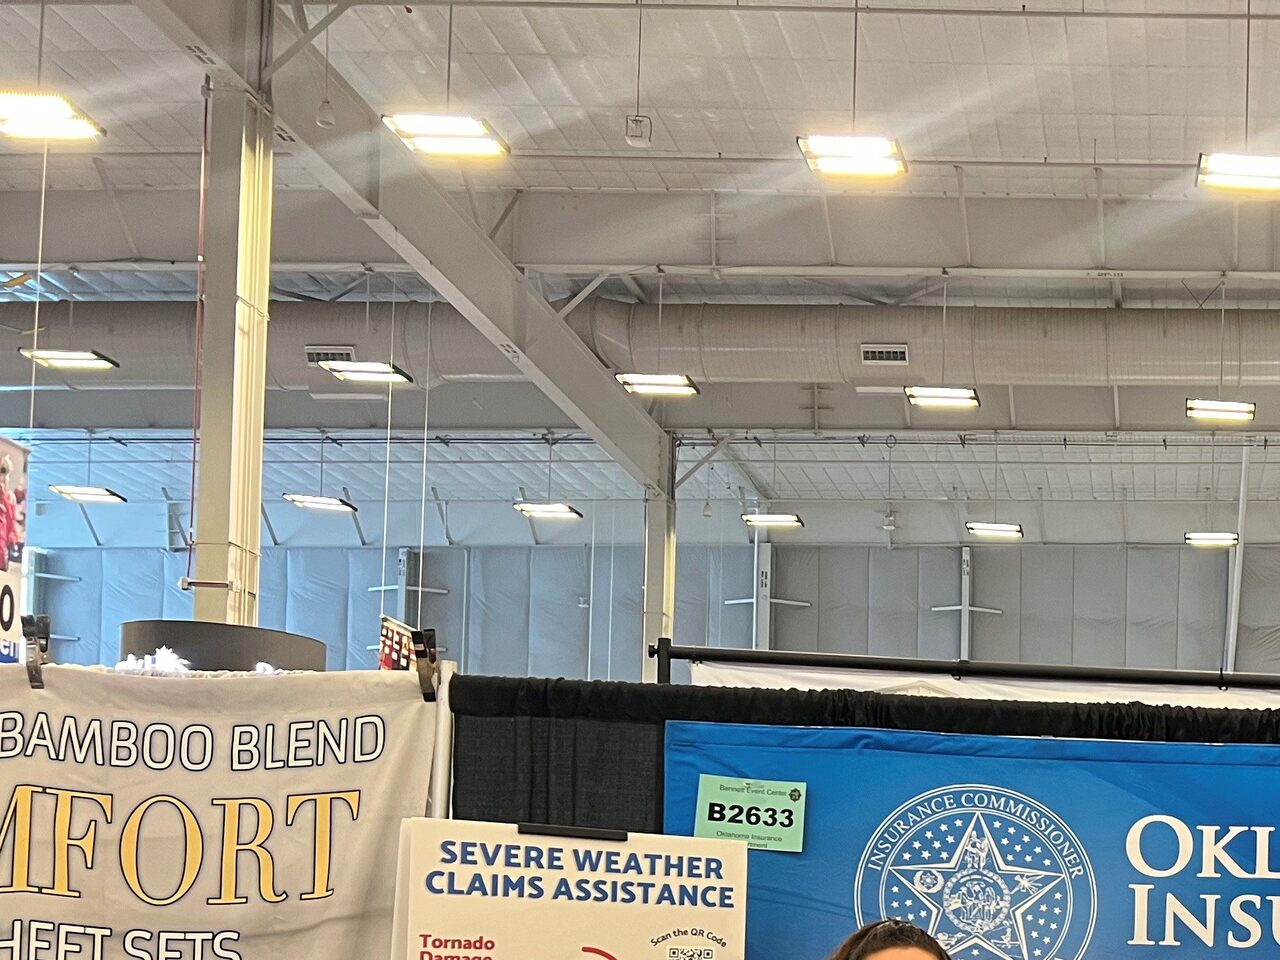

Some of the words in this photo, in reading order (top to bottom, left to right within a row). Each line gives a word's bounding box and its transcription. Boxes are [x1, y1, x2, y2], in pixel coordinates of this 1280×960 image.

[0, 711, 214, 772] BAMBOO
[230, 714, 386, 773] BLEND
[707, 802, 794, 828] B2633
[716, 830, 750, 840] Oklahoma
[750, 832, 783, 842] Insurance
[868, 793, 957, 872] INSURANCE
[960, 792, 1084, 880] COMMISSIONER
[439, 840, 564, 870] SEVERE
[572, 848, 723, 880] WEATHER
[425, 870, 544, 899] CLAIMS
[551, 877, 734, 908] ASSISTANCE
[418, 934, 495, 950] Tornado
[650, 932, 672, 946] Scan
[673, 928, 689, 937] the
[690, 928, 705, 937] QR
[706, 932, 727, 948] Code
